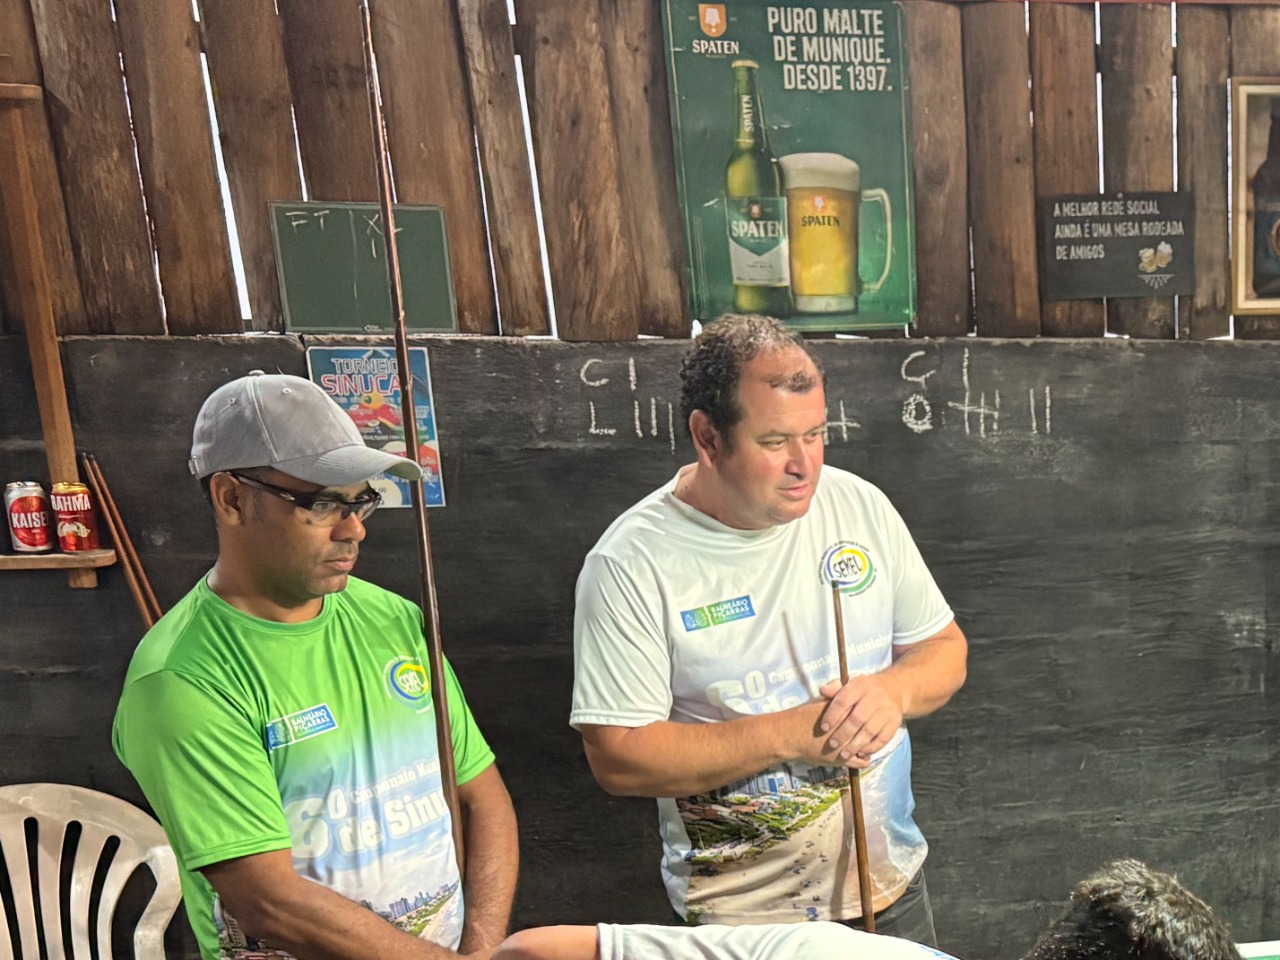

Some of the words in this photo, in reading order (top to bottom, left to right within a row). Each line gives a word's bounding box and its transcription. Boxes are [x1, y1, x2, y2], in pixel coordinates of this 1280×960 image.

[767, 7, 817, 34] PURO
[823, 8, 884, 35] MALTE
[692, 39, 739, 54] SPATEN
[773, 35, 798, 61] DE
[802, 36, 891, 65] MUNIQUE.
[783, 64, 843, 90] DESDE
[847, 65, 892, 91] 1397.
[741, 94, 754, 132] SPATEN
[1053, 203, 1061, 217] A
[1062, 202, 1099, 216] MELHOR
[1101, 201, 1125, 215] REDE
[1127, 200, 1160, 214] SOCIAL
[731, 220, 784, 238] SPATEN
[801, 215, 840, 227] SPATEN
[1055, 223, 1082, 238] AINDA
[1084, 219, 1091, 238] É
[1092, 222, 1113, 237] UMA
[1114, 221, 1140, 236] MESA
[1142, 220, 1184, 235] RODEADA
[1056, 245, 1068, 260] DE
[1070, 243, 1105, 259] AMIGOS
[321, 374, 401, 396] SINUCA
[340, 817, 382, 853] de
